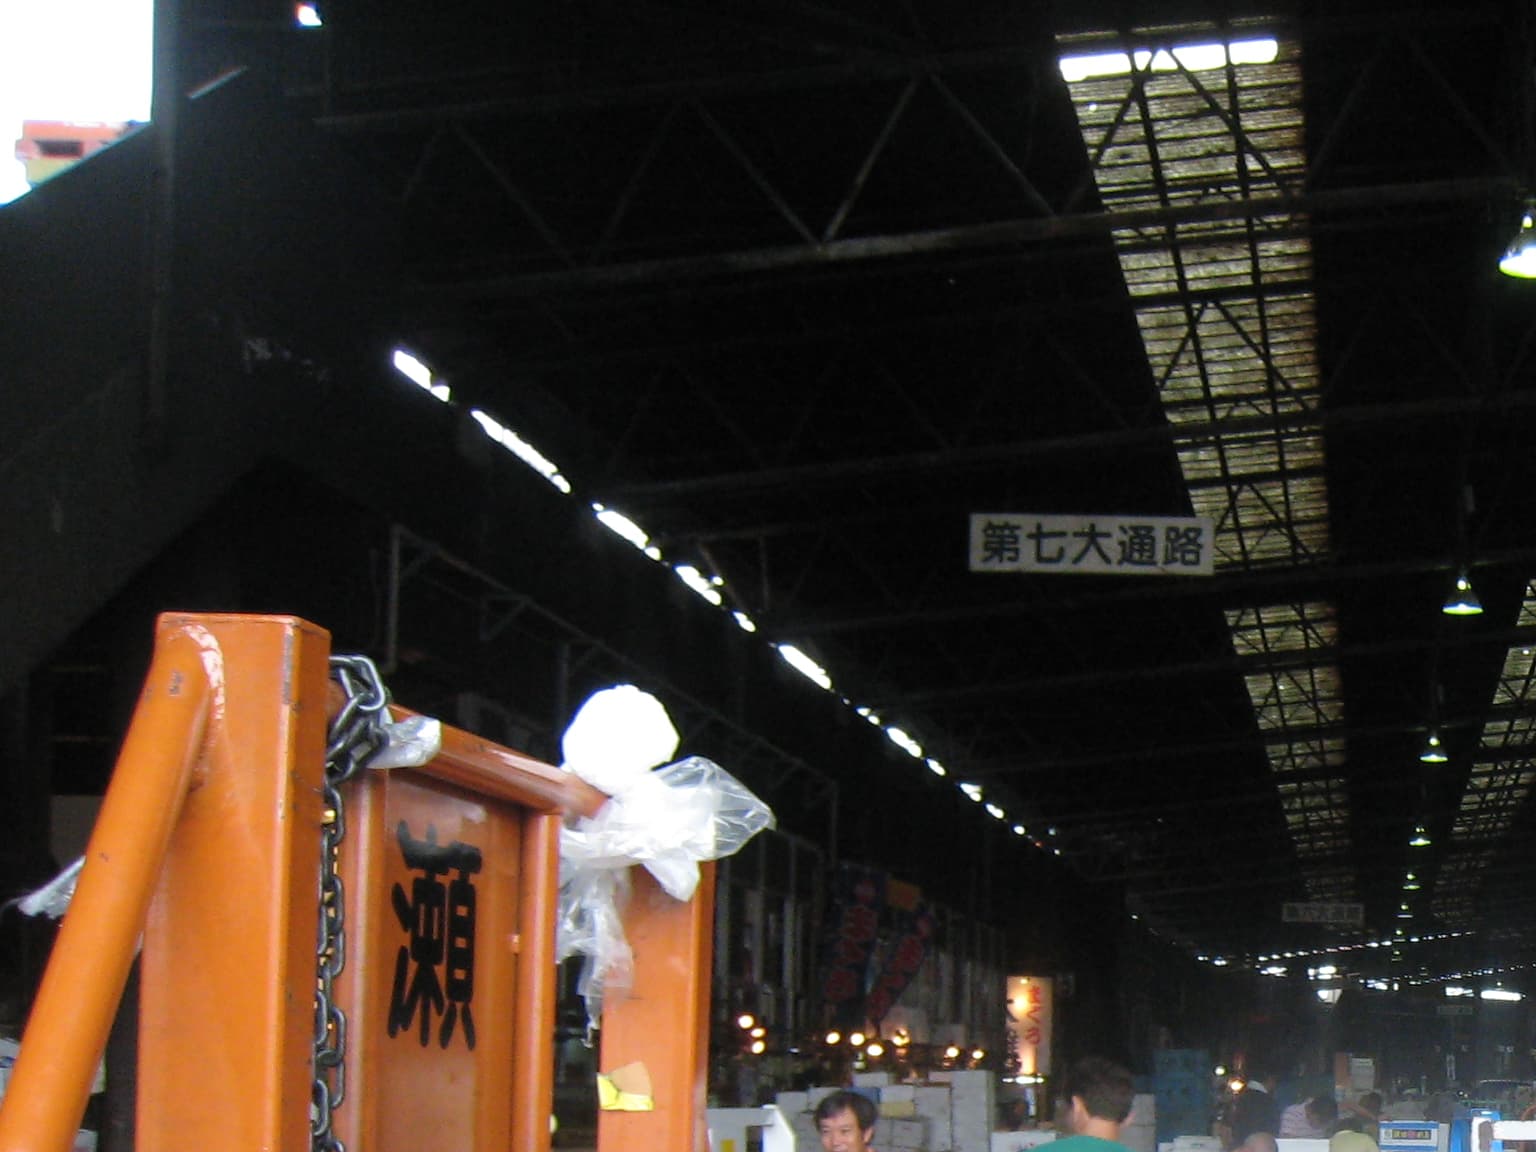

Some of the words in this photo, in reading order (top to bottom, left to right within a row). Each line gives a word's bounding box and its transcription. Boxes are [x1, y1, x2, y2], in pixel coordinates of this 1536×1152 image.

[981, 521, 1204, 566] 第七大通路
